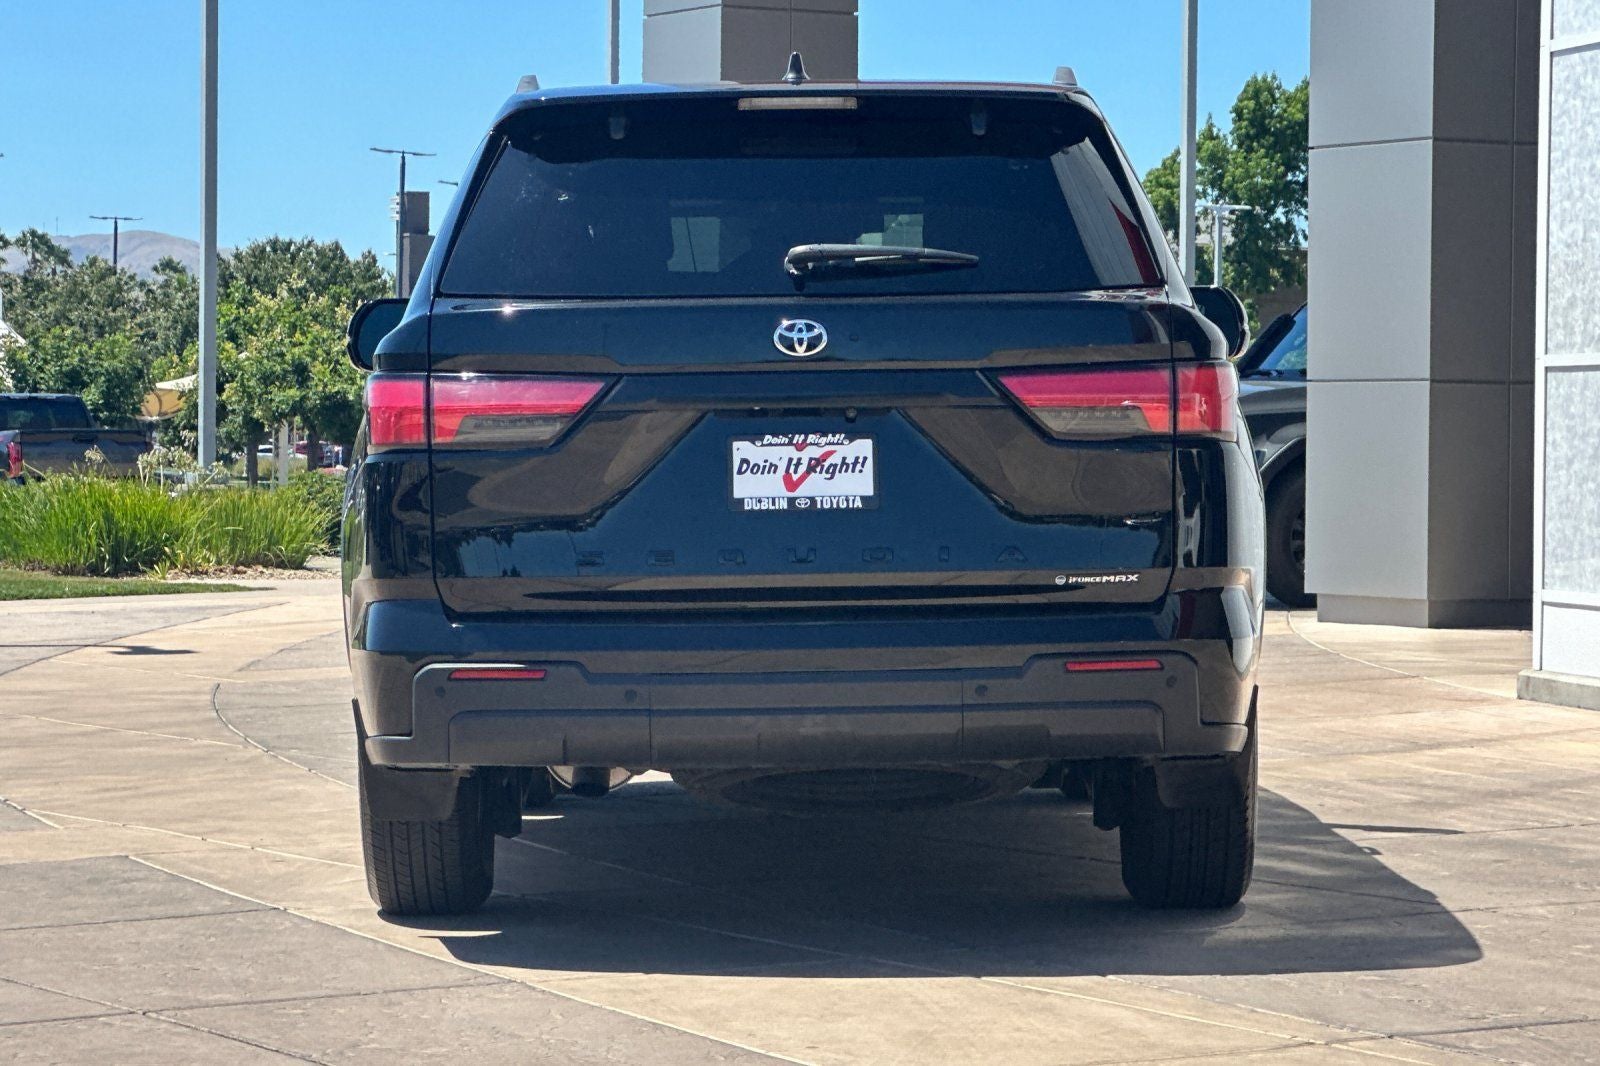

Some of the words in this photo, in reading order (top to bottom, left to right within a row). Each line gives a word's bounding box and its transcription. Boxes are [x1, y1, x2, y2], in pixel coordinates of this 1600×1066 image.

[762, 434, 792, 445] Doin'
[793, 434, 805, 444] It
[806, 433, 845, 446] Right!
[736, 456, 783, 475] Doin'
[784, 456, 803, 474] It
[806, 455, 868, 480] Right!
[744, 497, 788, 510] DUBLIN
[815, 496, 863, 509] TOYOTA
